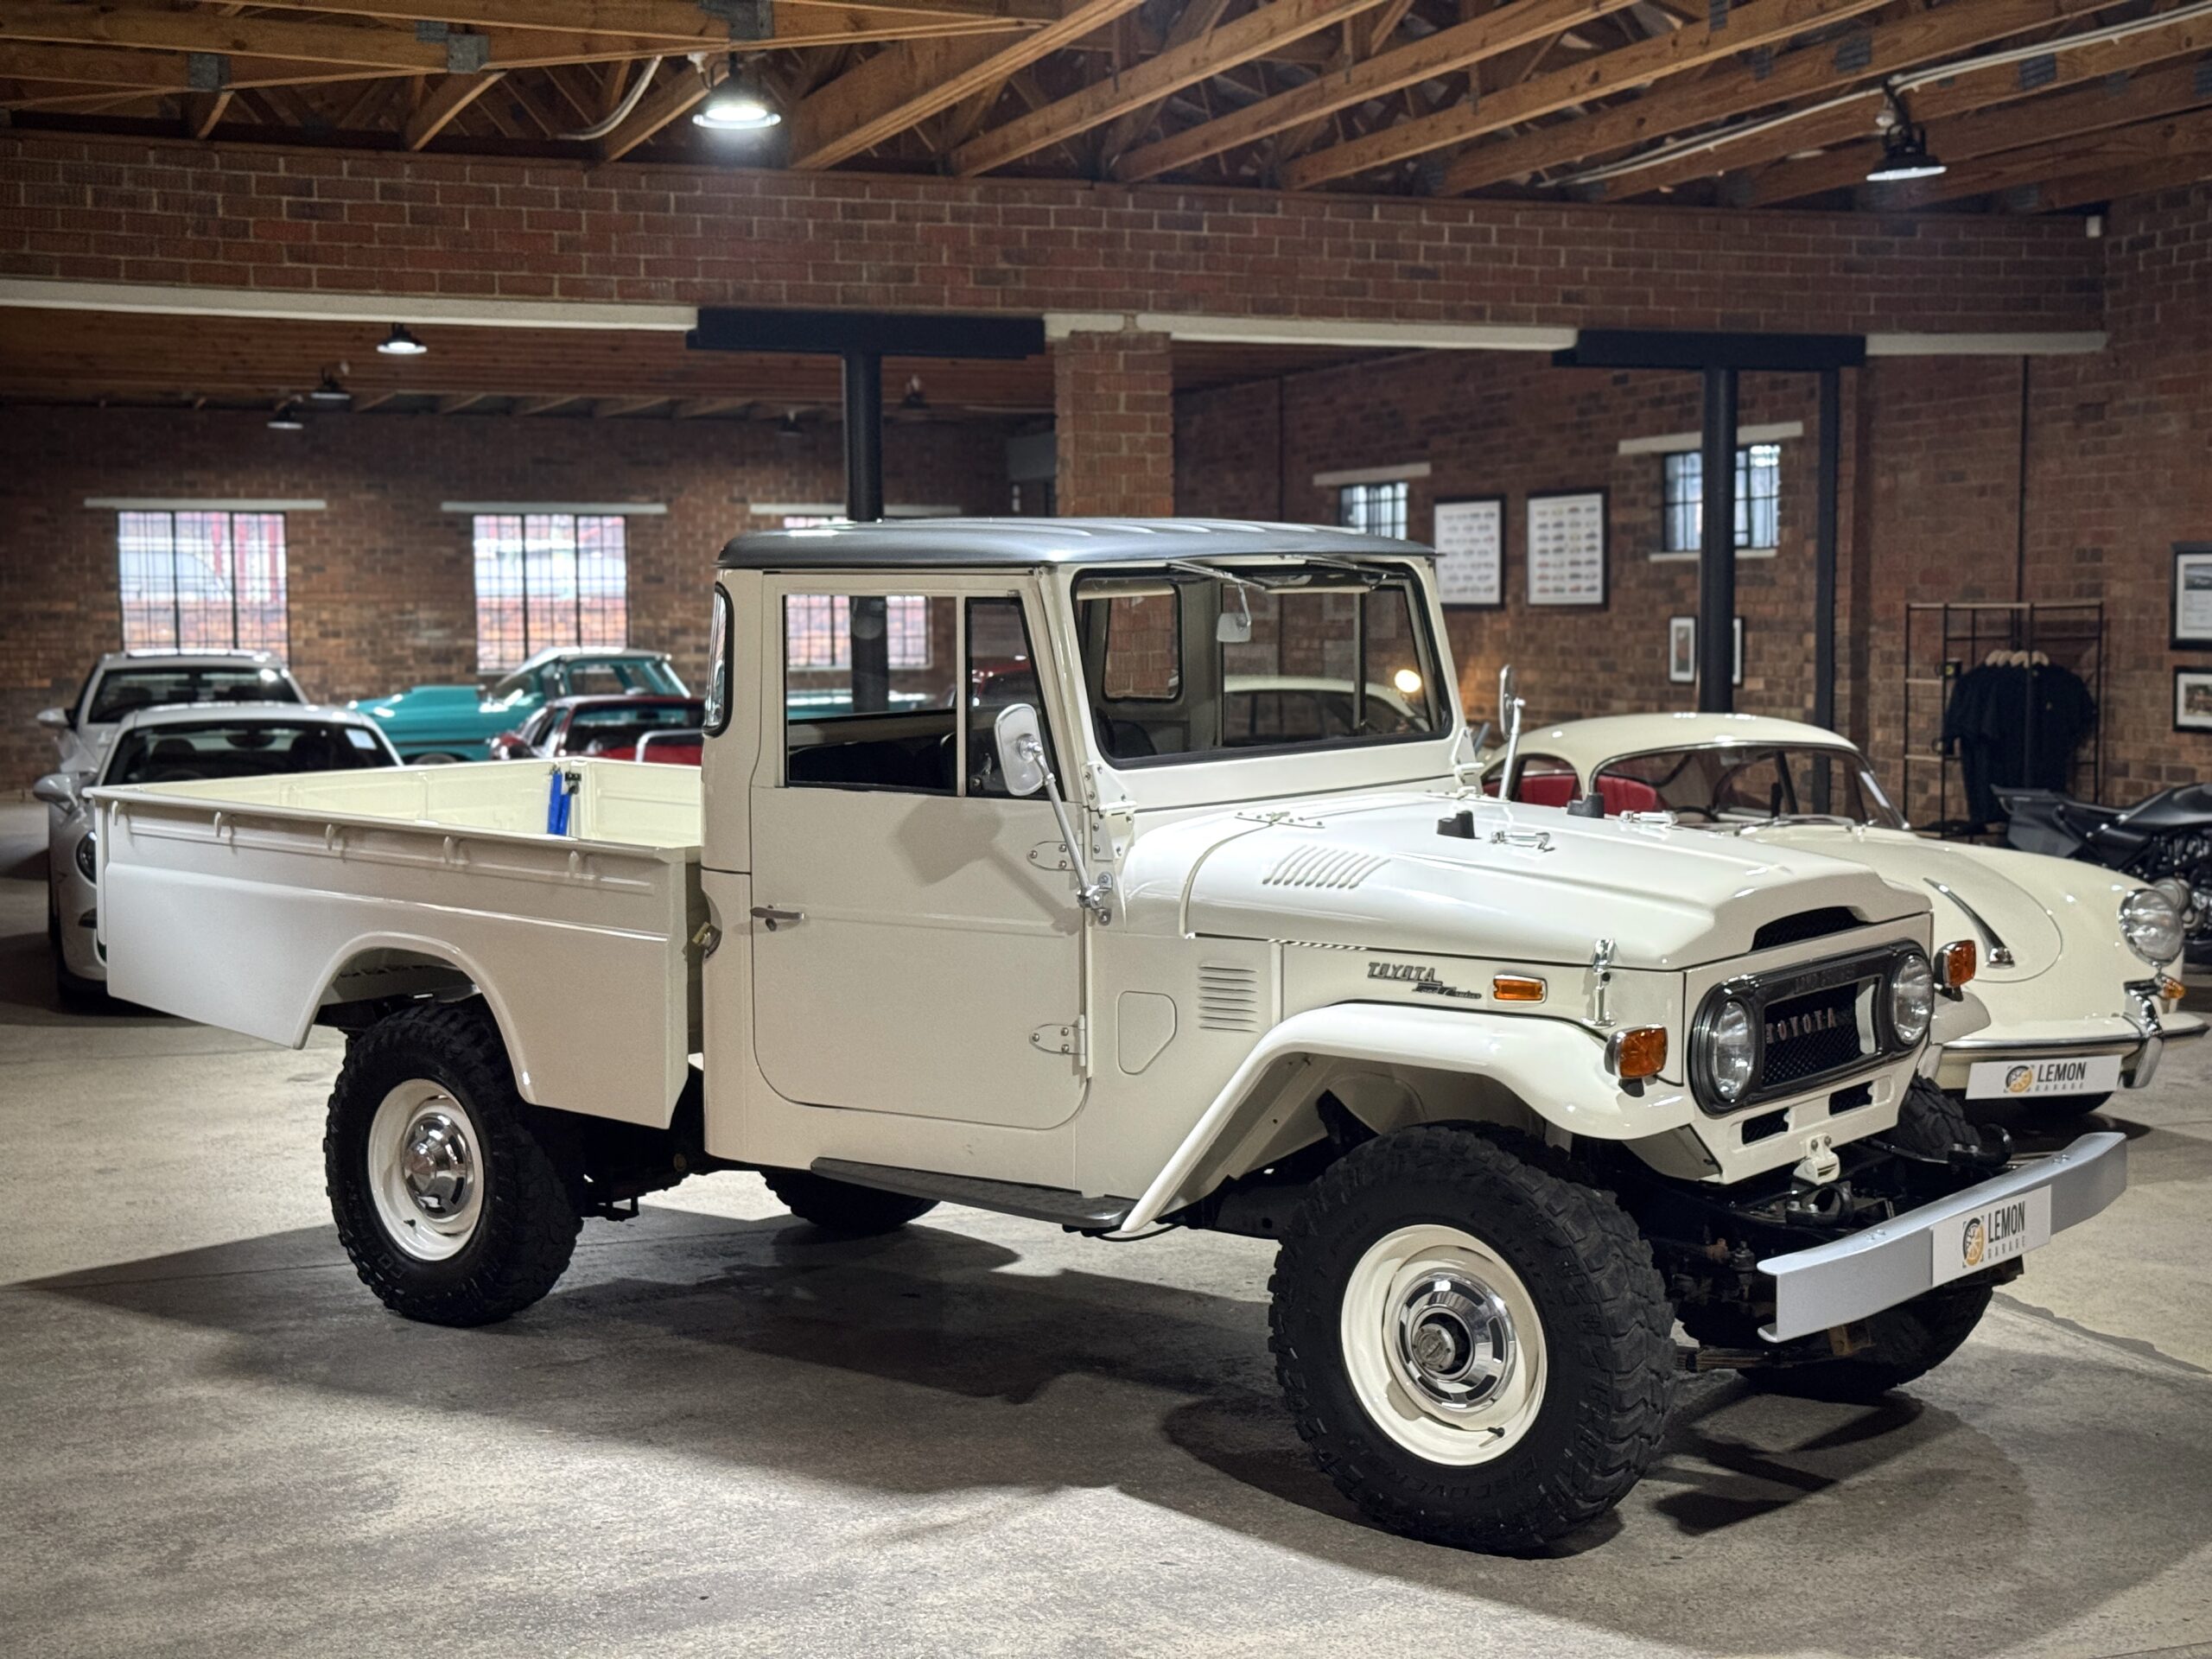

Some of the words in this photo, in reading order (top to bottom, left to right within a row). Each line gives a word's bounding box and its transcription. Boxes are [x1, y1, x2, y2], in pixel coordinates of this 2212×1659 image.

[1368, 962, 1436, 982] TOYOTA
[1764, 1007, 1838, 1045] TOYOTA
[2037, 1062, 2087, 1084] LEMON
[1988, 1200, 2025, 1243] LEMON
